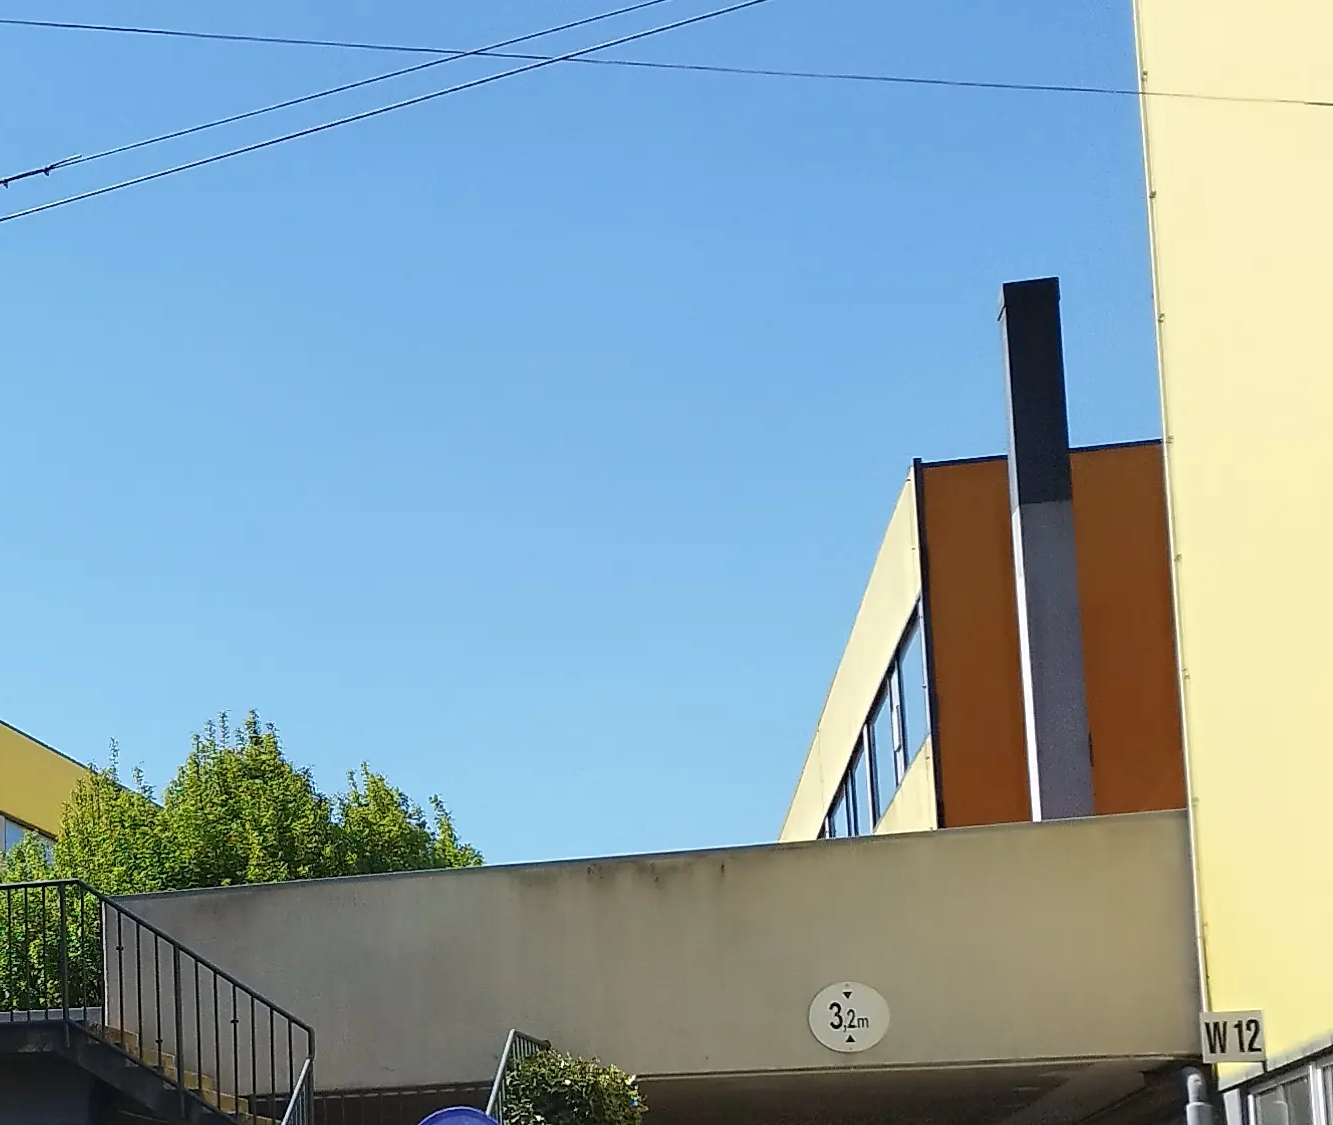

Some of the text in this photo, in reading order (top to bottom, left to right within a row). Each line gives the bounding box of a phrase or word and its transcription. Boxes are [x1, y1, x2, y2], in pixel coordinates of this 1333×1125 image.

[828, 1001, 870, 1033] 3,2m
[1204, 1019, 1262, 1054] W 12
